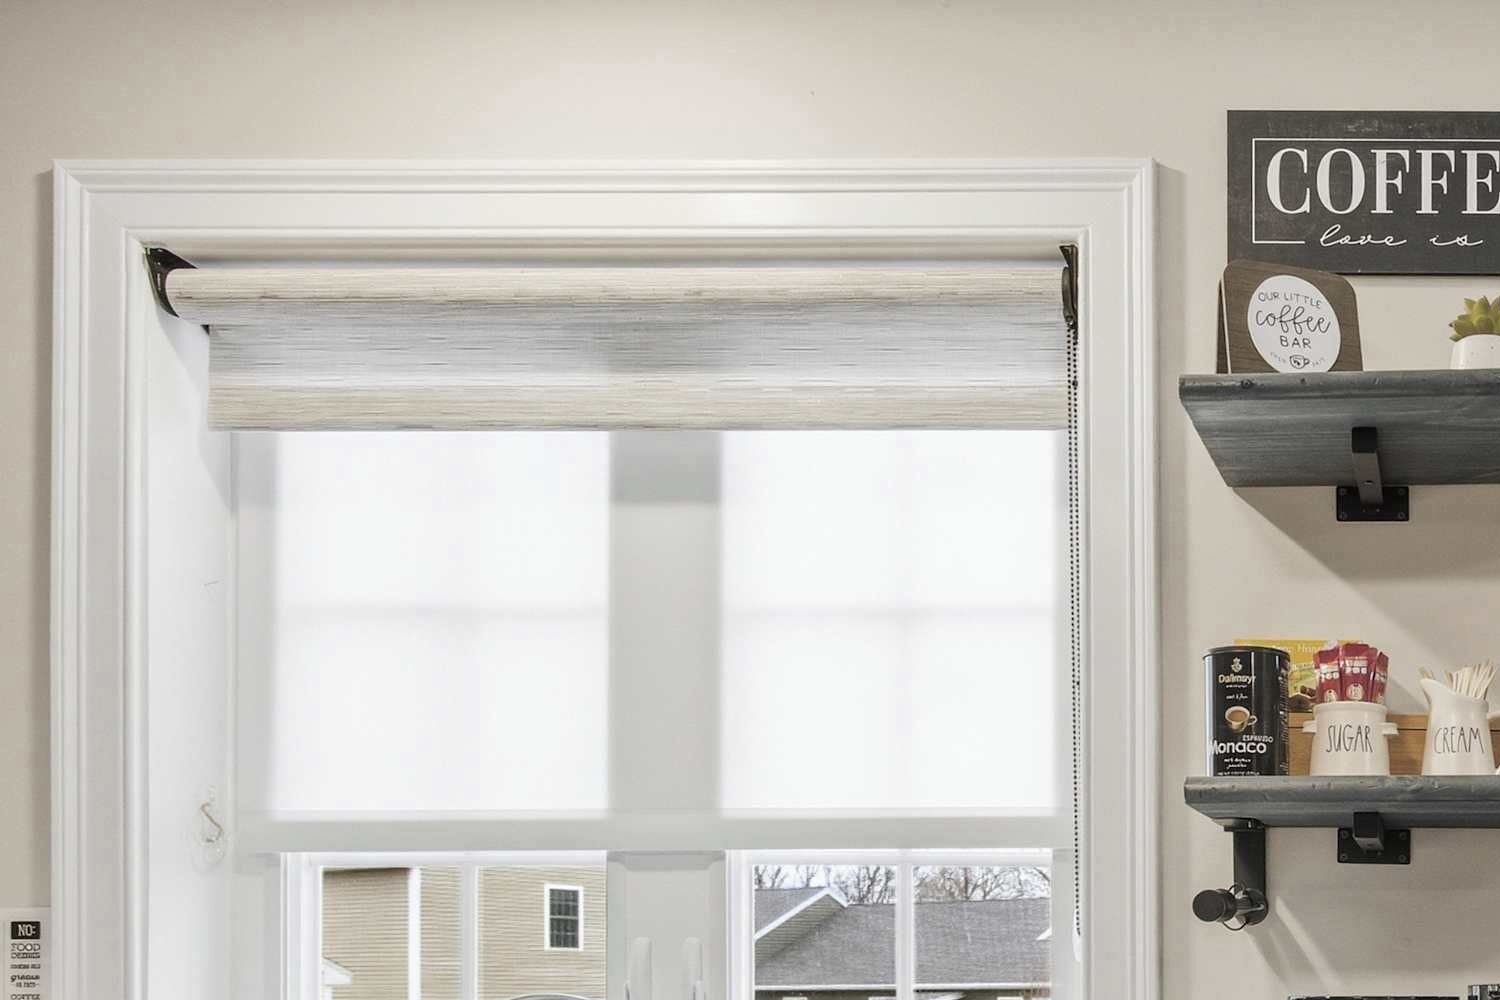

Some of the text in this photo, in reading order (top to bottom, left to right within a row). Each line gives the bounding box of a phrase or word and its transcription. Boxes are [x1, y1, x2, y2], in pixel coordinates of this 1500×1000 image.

[1320, 223, 1407, 248] love
[1429, 234, 1484, 248] is
[1257, 291, 1322, 310] OUR LITTLE
[1255, 304, 1332, 336] coffee
[1279, 335, 1313, 349] BAR
[1211, 739, 1267, 755] Monaco
[1326, 723, 1374, 753] SUGAR
[1433, 726, 1485, 755] CREAM
[10, 942, 41, 952] FOOD
